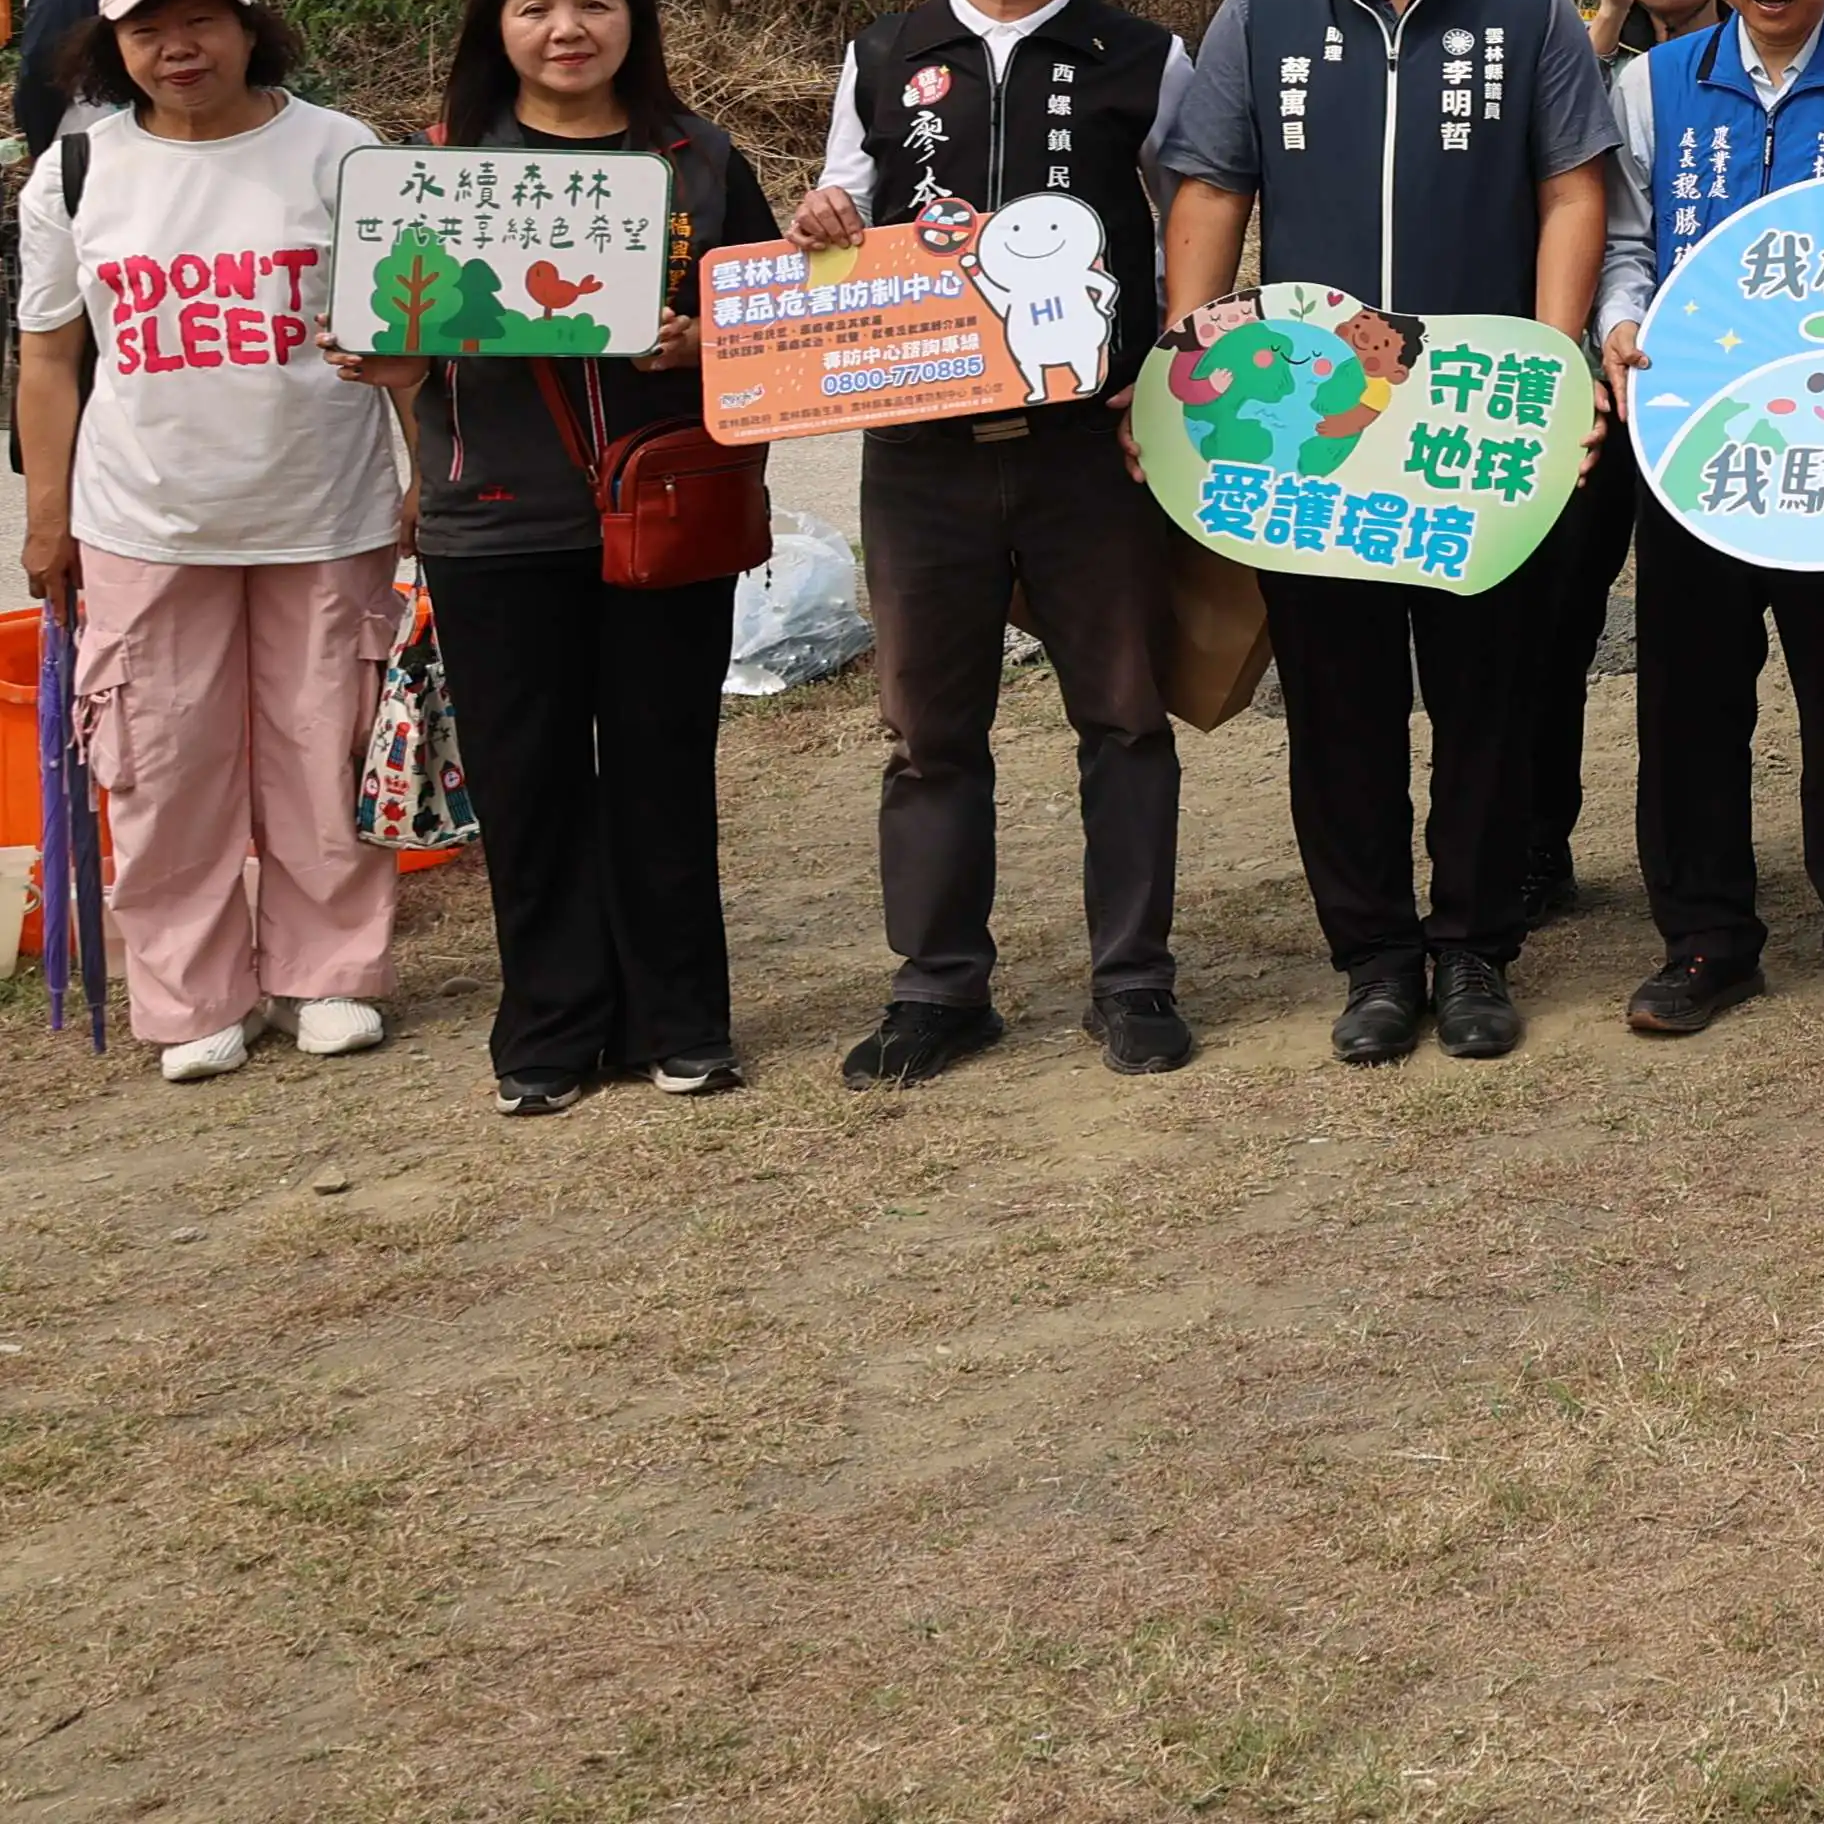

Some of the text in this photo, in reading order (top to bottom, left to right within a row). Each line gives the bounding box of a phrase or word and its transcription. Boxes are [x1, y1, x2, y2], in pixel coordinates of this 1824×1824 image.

[1324, 26, 1344, 62] 助理
[1483, 27, 1505, 120] 雲林縣議員
[1046, 62, 1076, 189] 西螺鎮民
[1440, 59, 1473, 151] 李明哲
[399, 161, 612, 210] 永續森林
[355, 212, 650, 254] 世代共享綠色希望
[711, 252, 806, 293] 雲林縣
[711, 268, 965, 328] 毒品危害防制中心
[116, 301, 308, 376] SLEEP
[1029, 296, 1064, 327] HI
[821, 354, 987, 397] 0800-770885
[1427, 343, 1564, 429] 守護
[1403, 421, 1546, 503] 地球
[1196, 462, 1477, 579] 愛護環境
